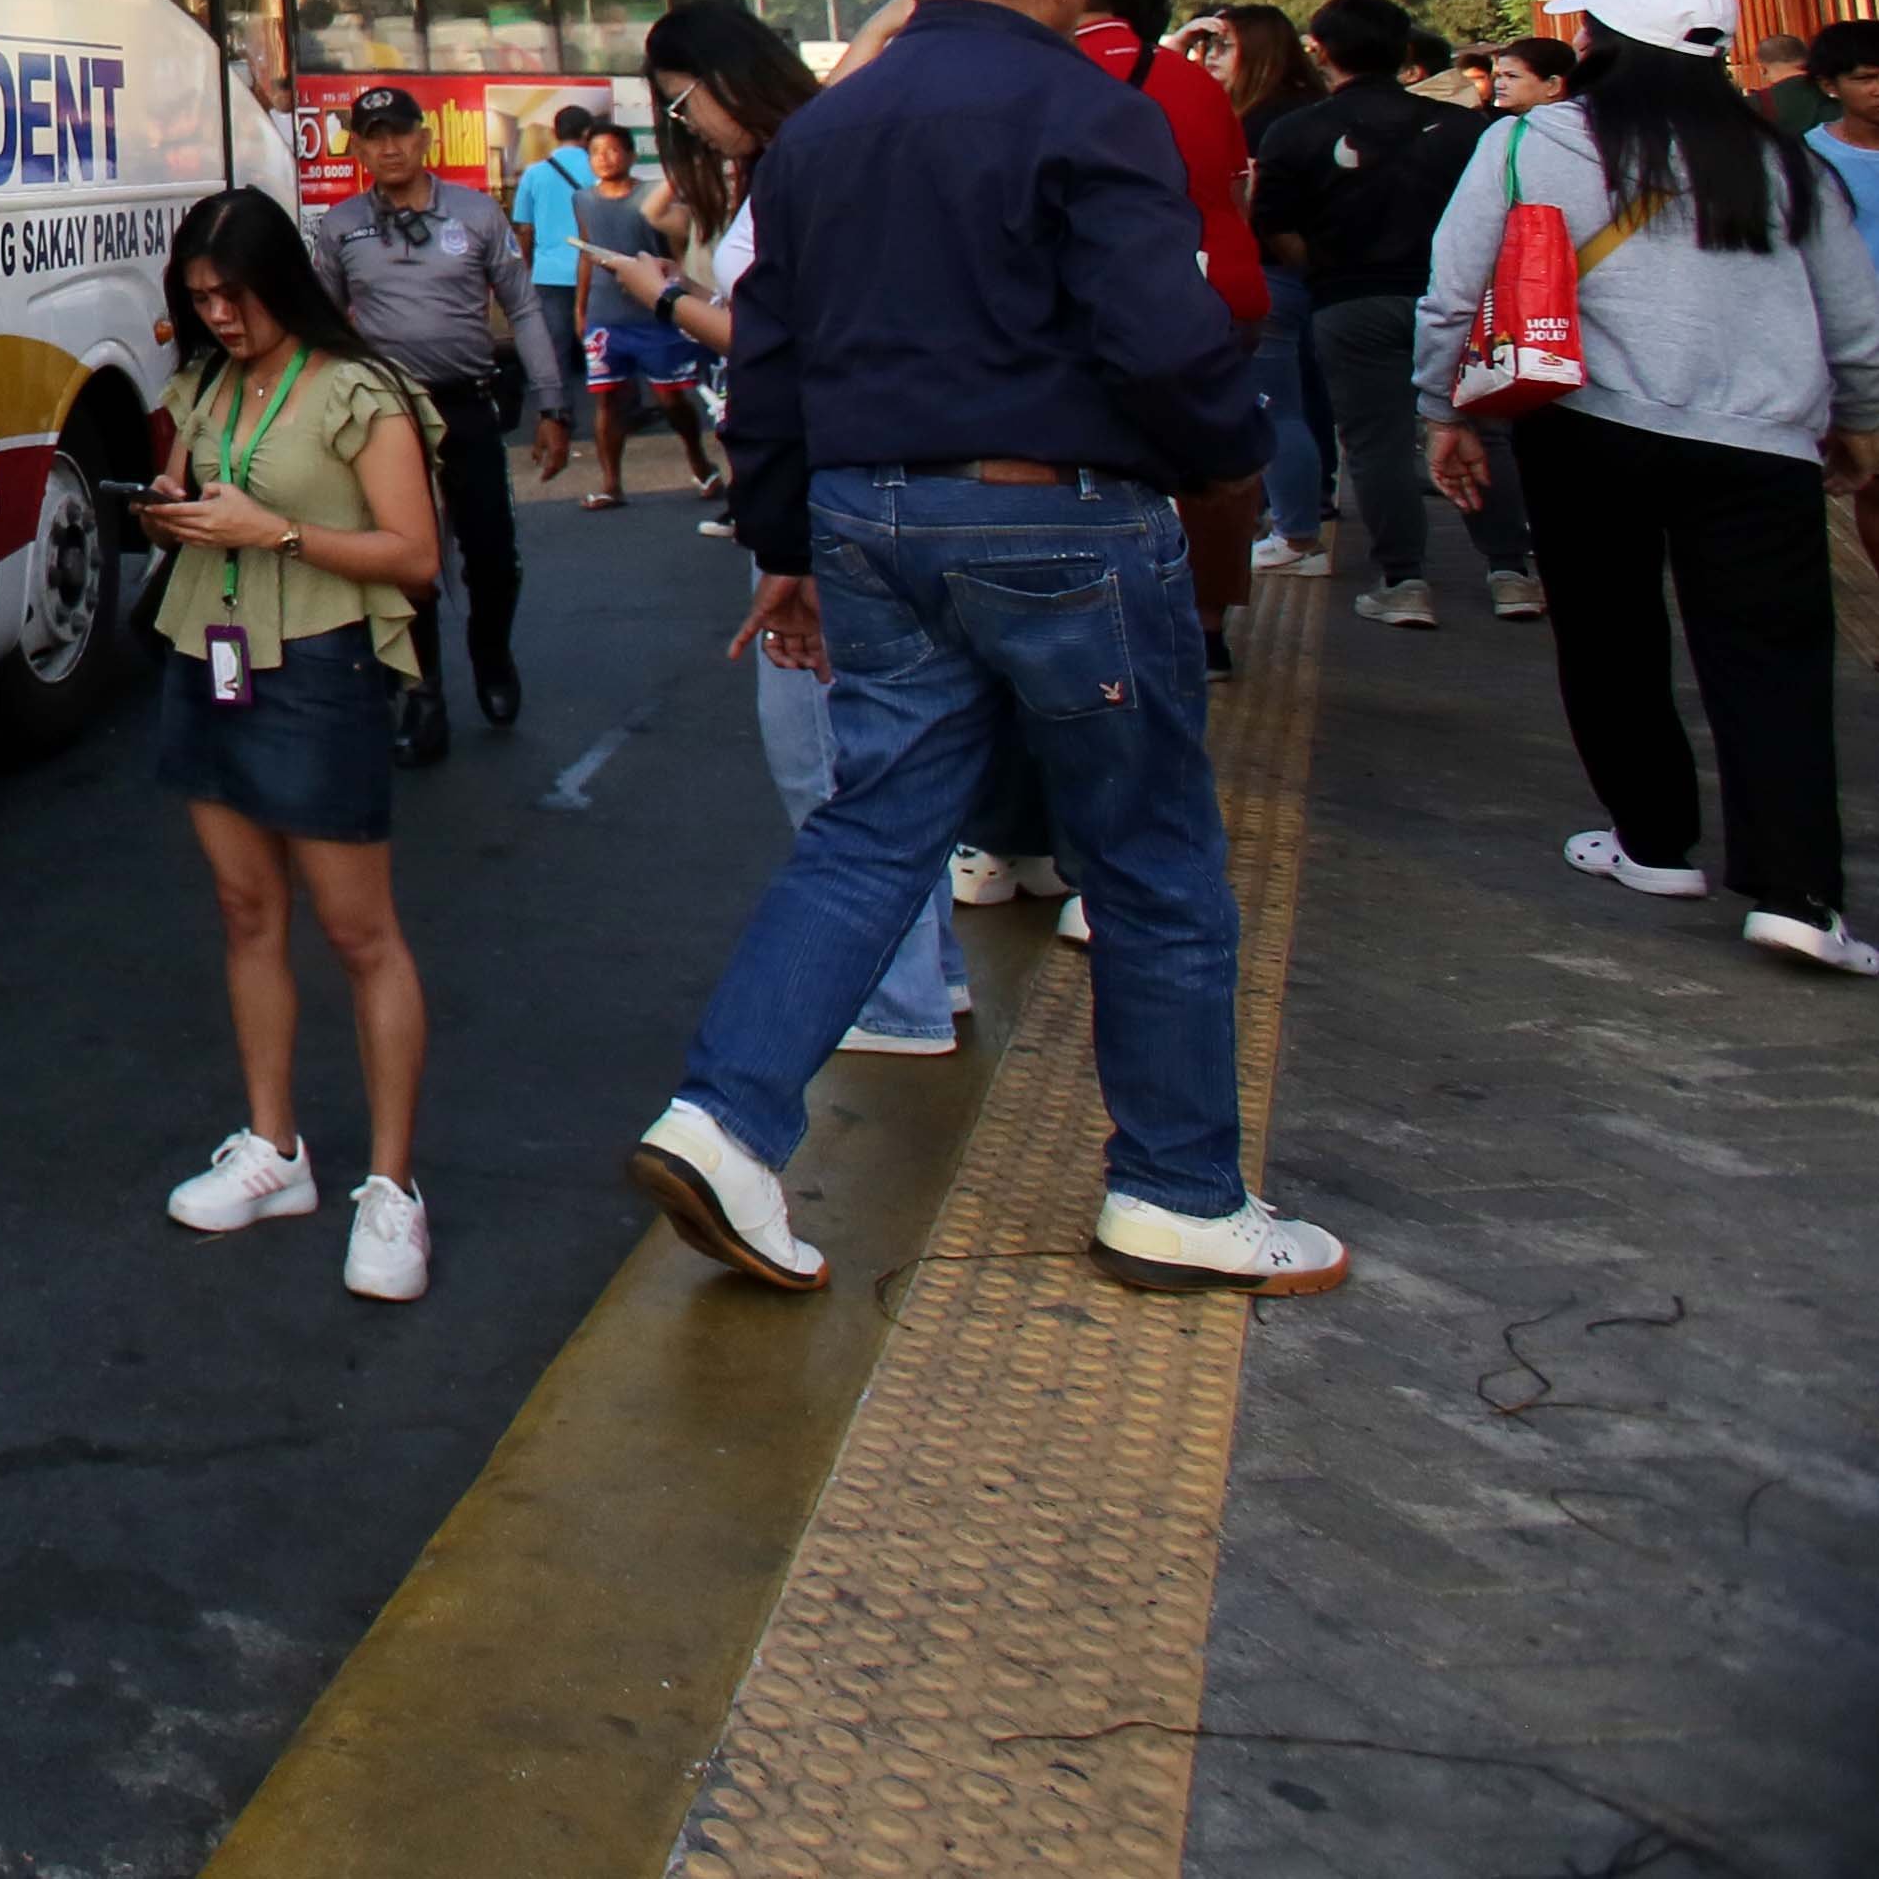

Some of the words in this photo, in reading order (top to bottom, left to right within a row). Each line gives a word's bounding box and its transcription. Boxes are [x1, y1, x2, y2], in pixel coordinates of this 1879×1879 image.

[23, 216, 87, 274] SAKAY
[94, 212, 139, 262] PARA
[144, 208, 165, 256] SA
[1526, 317, 1570, 330] HOLLY
[1524, 330, 1567, 342] JOLLY
